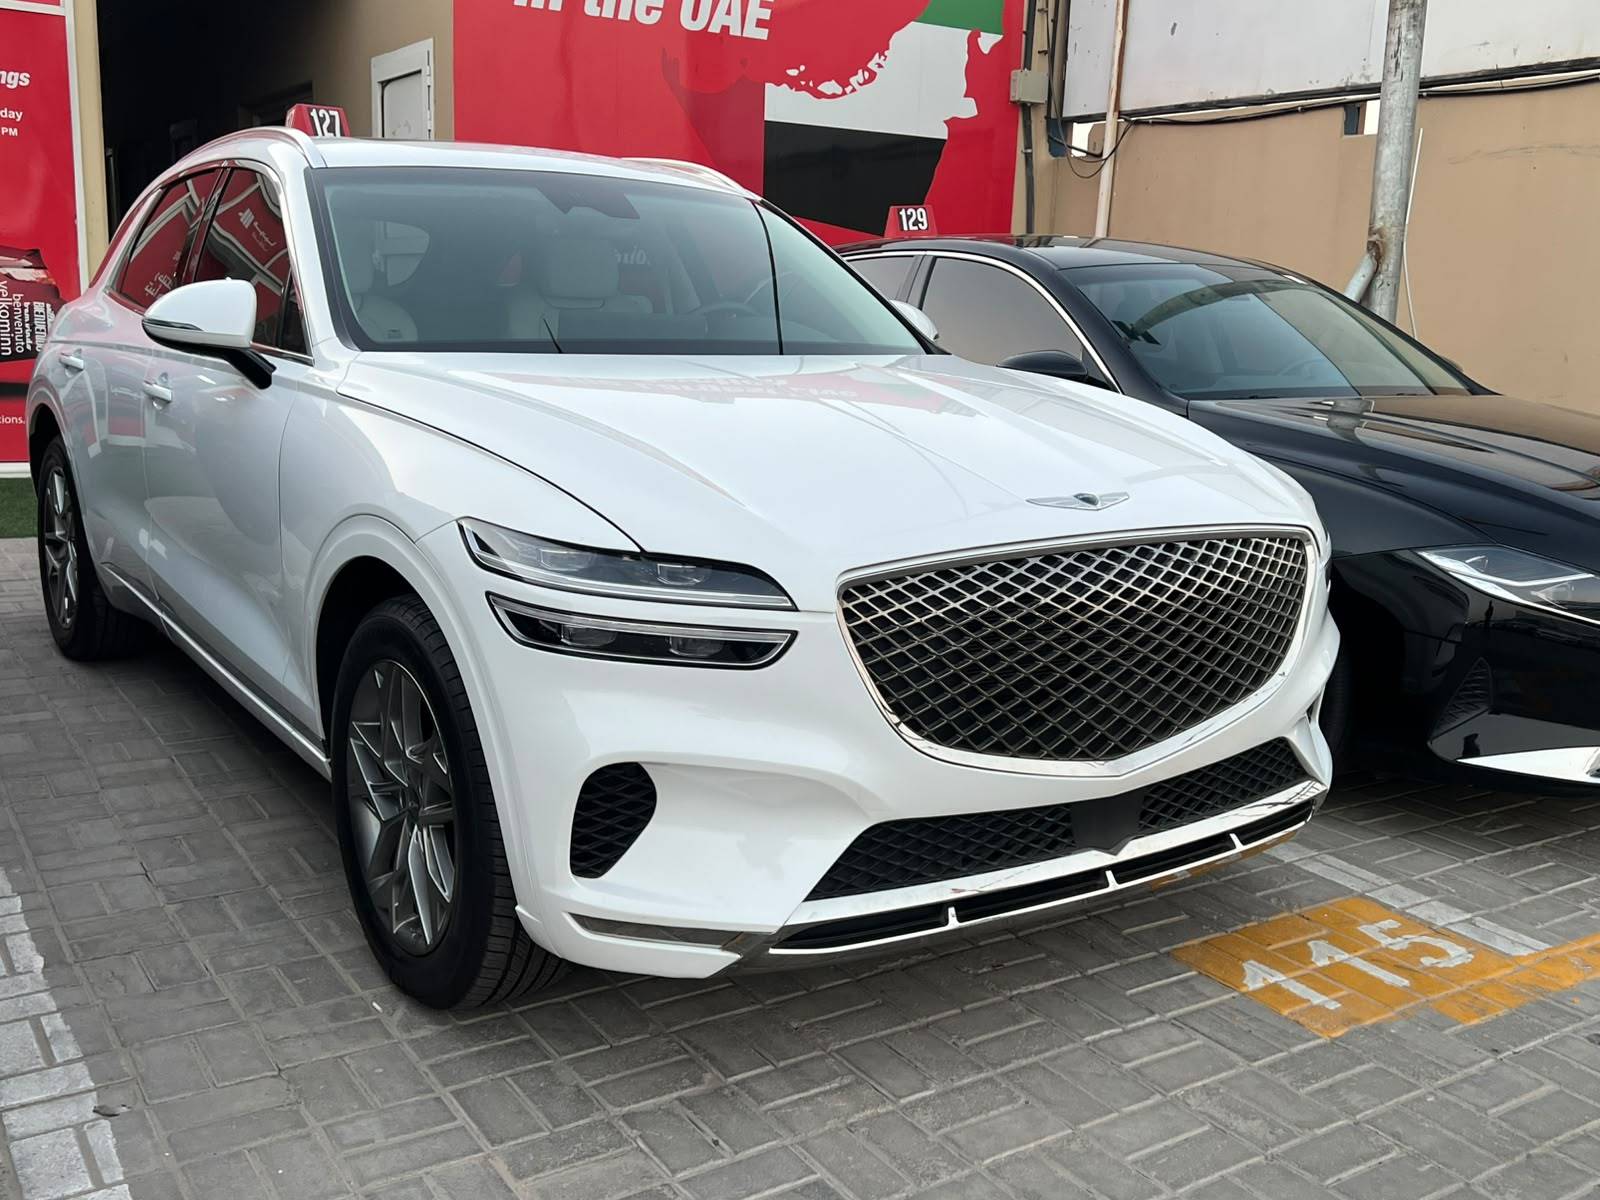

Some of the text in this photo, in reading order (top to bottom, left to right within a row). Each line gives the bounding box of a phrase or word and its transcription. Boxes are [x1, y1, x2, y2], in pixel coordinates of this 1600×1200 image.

[680, 0, 772, 41] UAE
[1, 126, 18, 137] PM
[310, 108, 341, 137] 127
[899, 207, 928, 231] 129
[12, 293, 25, 353] benvenuto
[1242, 919, 1474, 1010] 115
